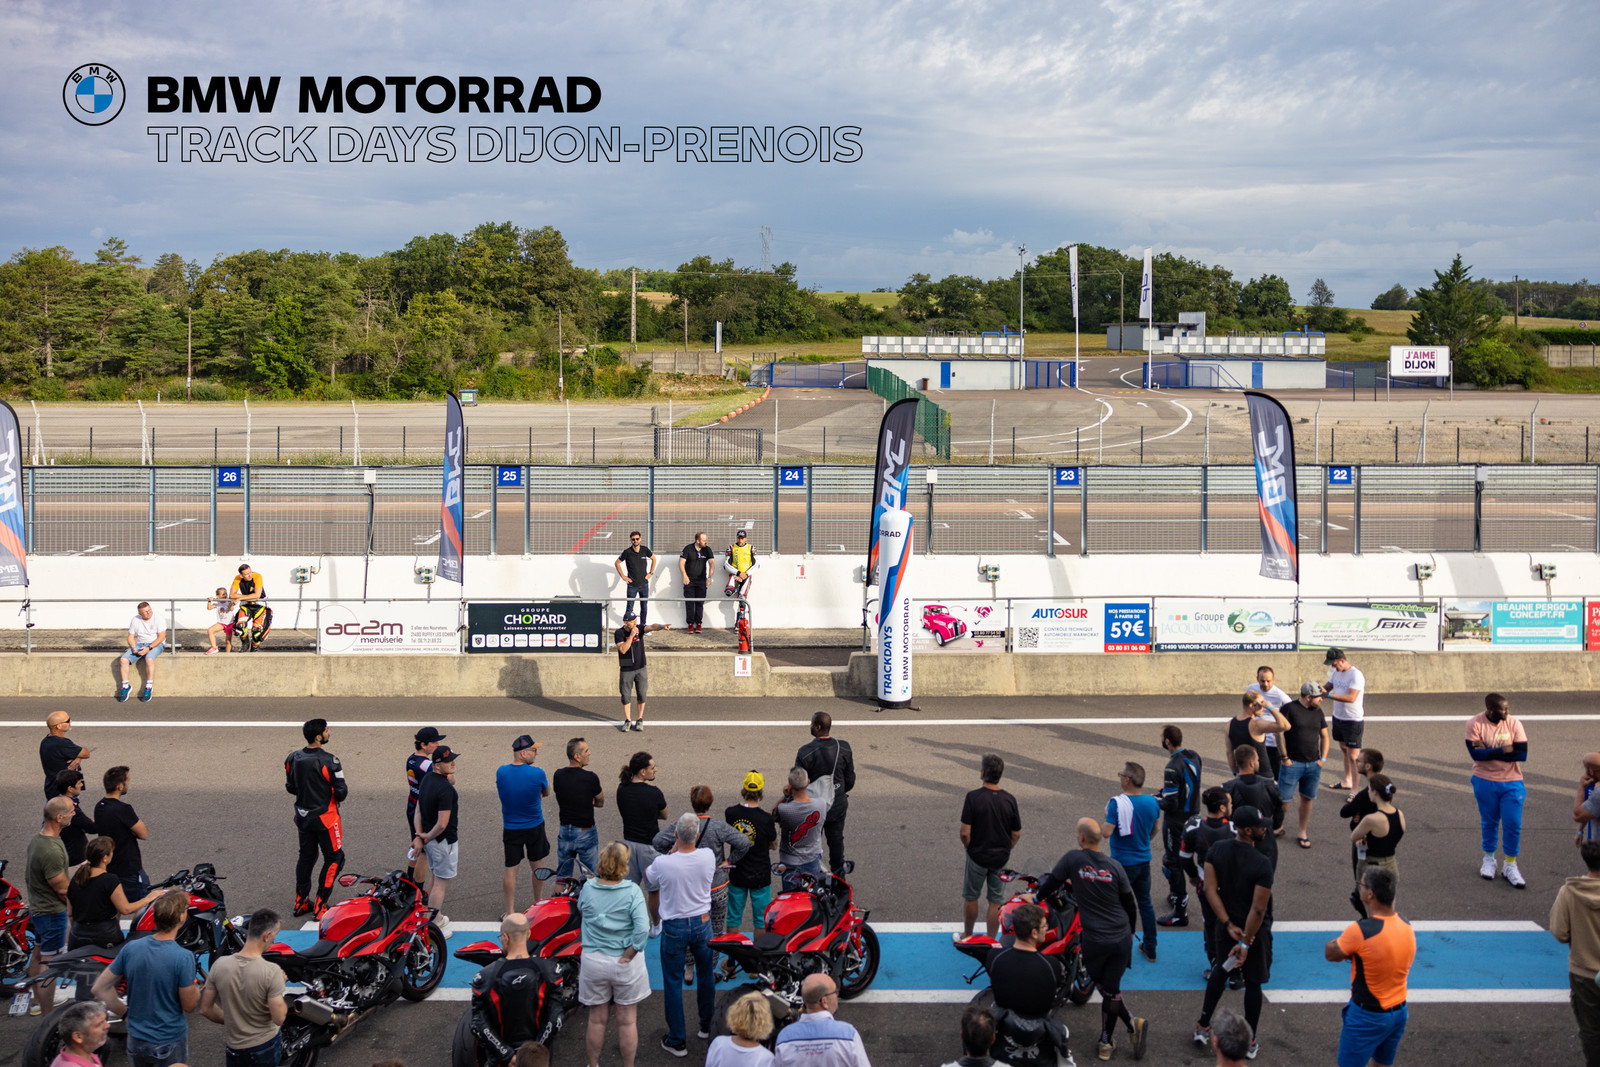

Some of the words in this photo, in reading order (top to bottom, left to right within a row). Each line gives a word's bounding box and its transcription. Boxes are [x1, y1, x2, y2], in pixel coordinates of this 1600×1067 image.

[1405, 351, 1436, 360] J'AIME
[1404, 360, 1436, 370] DIJON
[222, 472, 237, 482] 26
[502, 471, 517, 481] 25
[785, 470, 799, 480] 24
[1060, 470, 1075, 480] 23
[1333, 469, 1347, 480] 22
[1496, 603, 1533, 611] BEAUNE
[1535, 603, 1578, 611] PERGOLA
[1031, 608, 1088, 619] AUTOSUR
[1195, 612, 1225, 623] Groupe
[1509, 611, 1565, 619] CONCEPT.FR
[504, 614, 567, 625] CHOPARD
[325, 620, 403, 636] ac2m
[1110, 620, 1145, 639] 59€
[1161, 622, 1224, 636] JACQUINOT
[360, 636, 403, 644] menuiserie
[883, 626, 893, 696] TRACKDAYS
